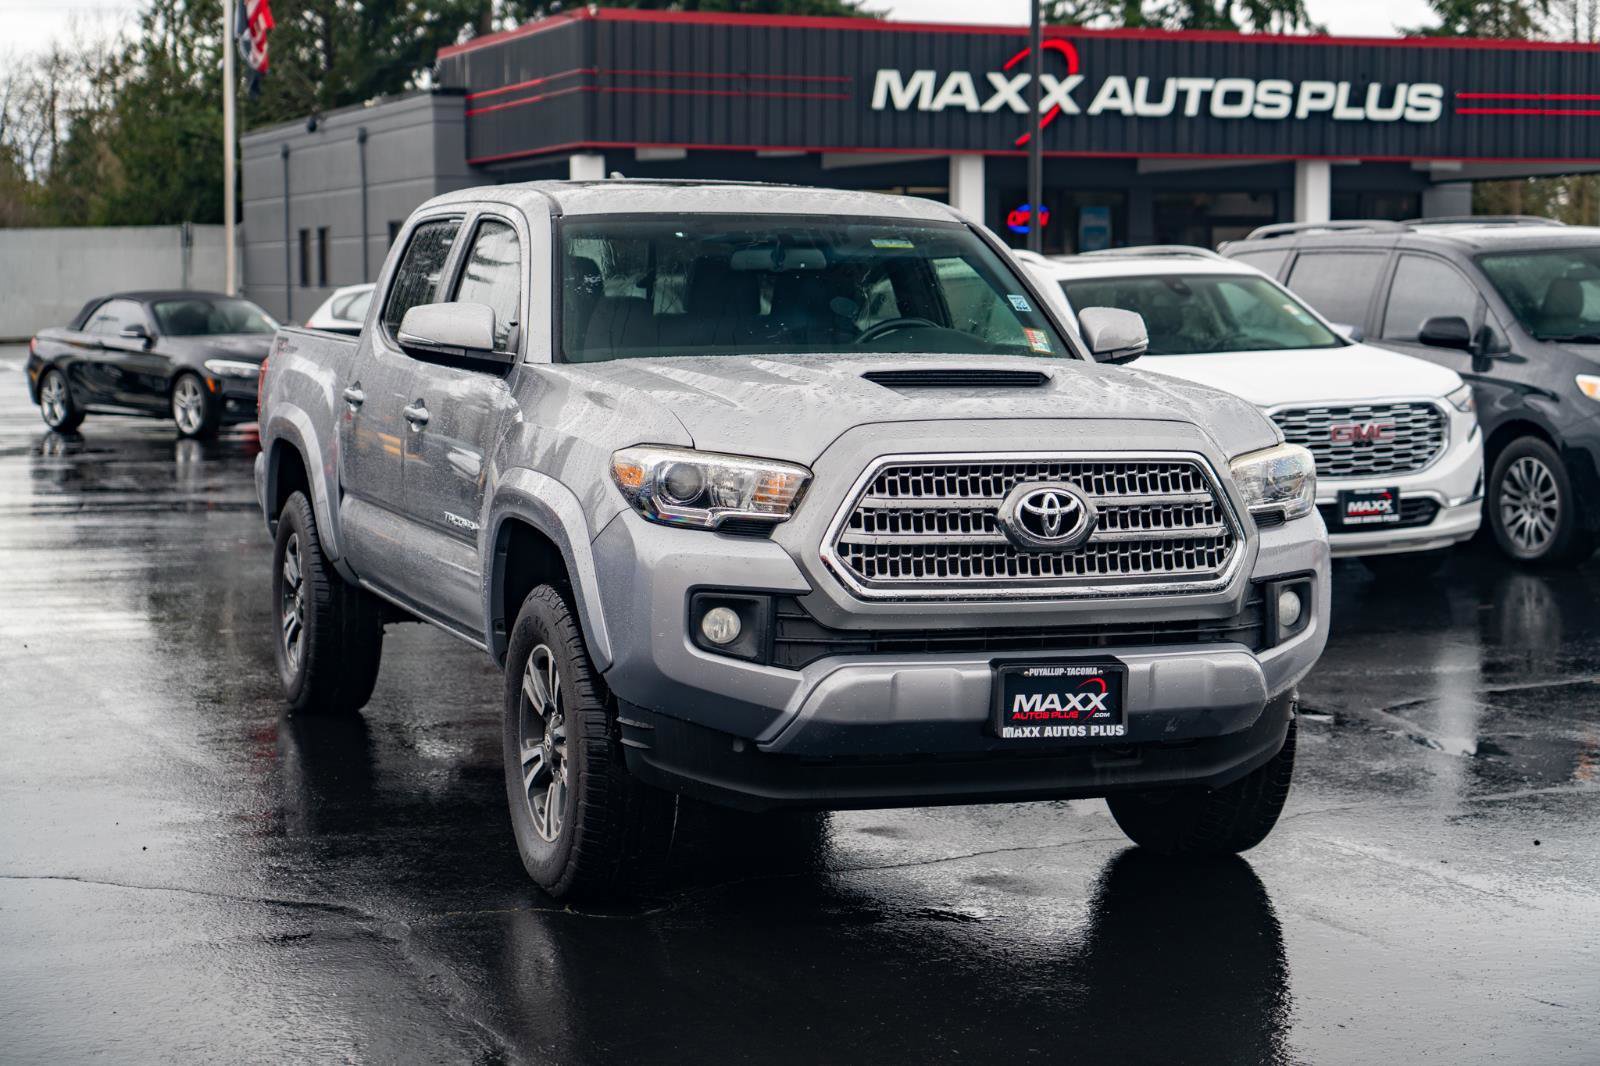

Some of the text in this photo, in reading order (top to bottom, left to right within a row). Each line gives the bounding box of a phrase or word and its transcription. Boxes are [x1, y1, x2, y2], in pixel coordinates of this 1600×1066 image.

[872, 69, 1444, 123] MAXX AUTOS PLUS
[1331, 422, 1396, 442] GMC
[1347, 500, 1393, 513] MAXX
[1013, 692, 1109, 713] MAXX
[1012, 710, 1079, 720] AUTOS PLUS
[1002, 724, 1125, 738] MAXX AUTOS PLUS
